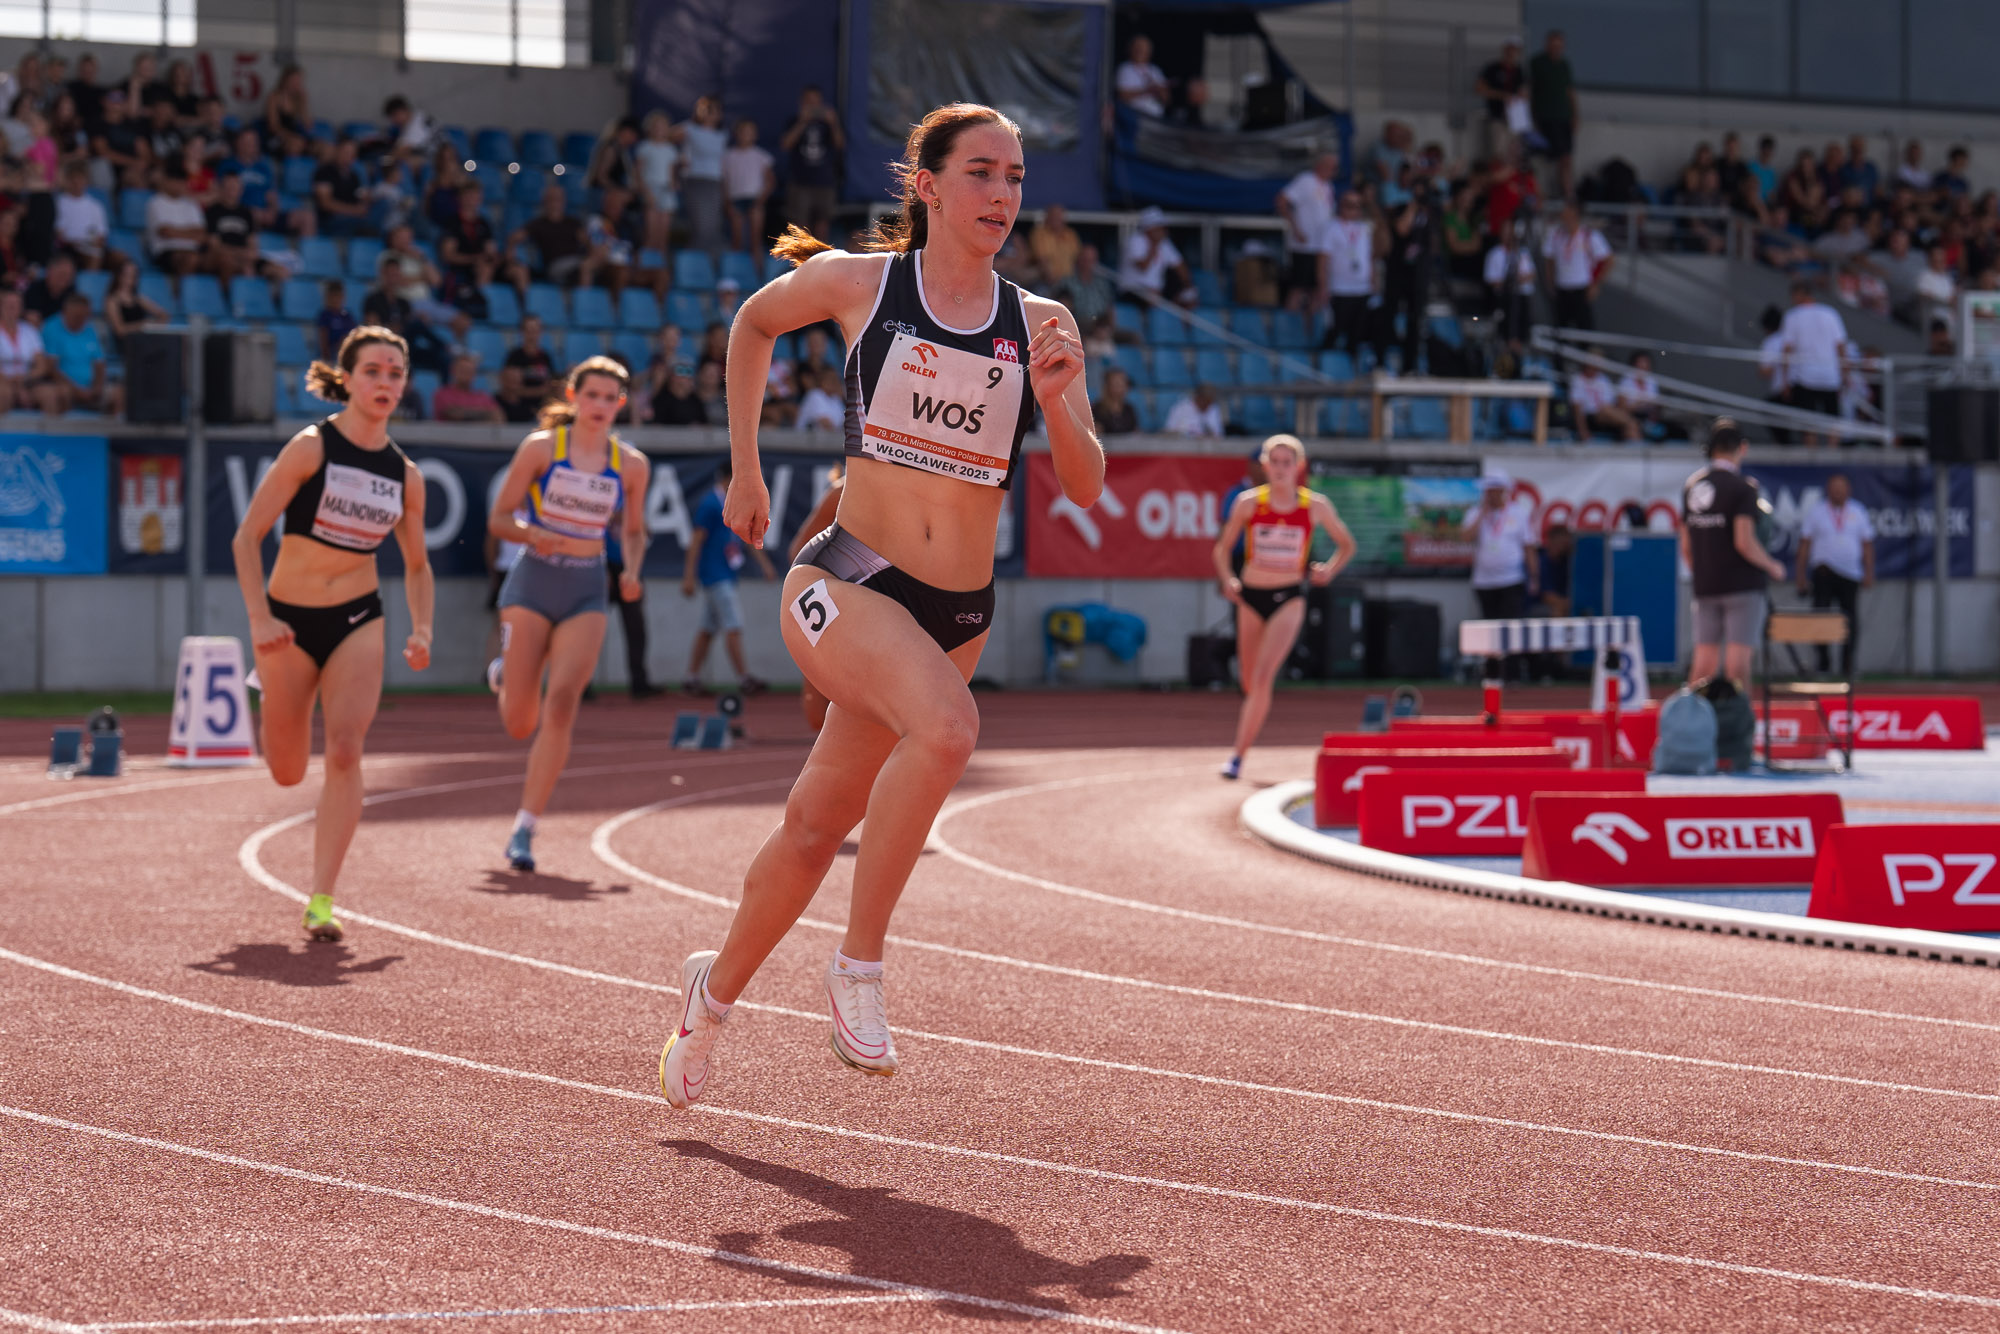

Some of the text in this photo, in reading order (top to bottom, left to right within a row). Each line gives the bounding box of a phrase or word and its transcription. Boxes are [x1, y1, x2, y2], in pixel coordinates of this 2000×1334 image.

[901, 362, 937, 380] ORLEN
[997, 351, 1018, 364] AZS
[986, 366, 1004, 390] 9
[912, 391, 987, 435] WOŚ
[876, 442, 990, 481] WŁOCŁAWEK 2025
[877, 428, 995, 466] 79. PZLA Mistrzostwa Polski U20
[798, 587, 827, 632] 5
[955, 612, 984, 624] esa
[206, 664, 237, 736] 5
[1676, 823, 1803, 851] ORLEN
[1882, 852, 2000, 907] PZ
